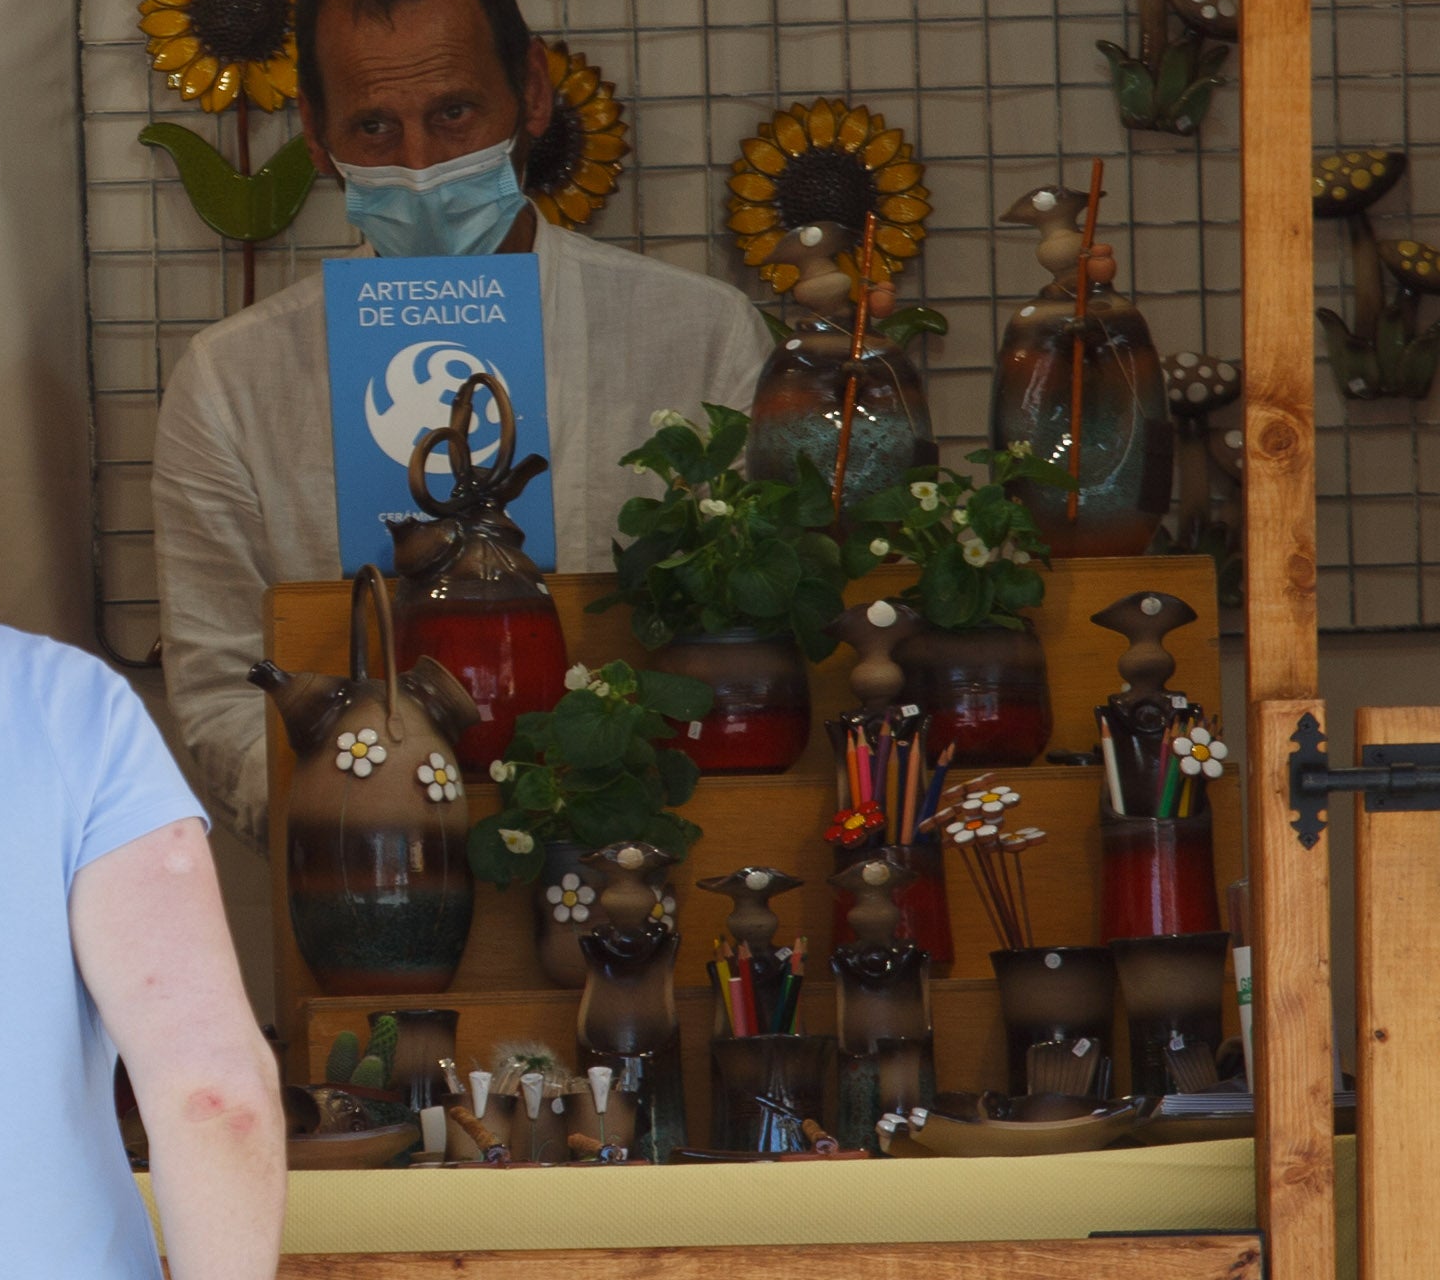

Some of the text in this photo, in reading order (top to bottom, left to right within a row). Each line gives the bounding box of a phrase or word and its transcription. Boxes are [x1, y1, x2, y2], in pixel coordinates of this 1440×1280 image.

[357, 274, 506, 302] ARTESANÍA
[358, 303, 507, 327] DE GALICIA
